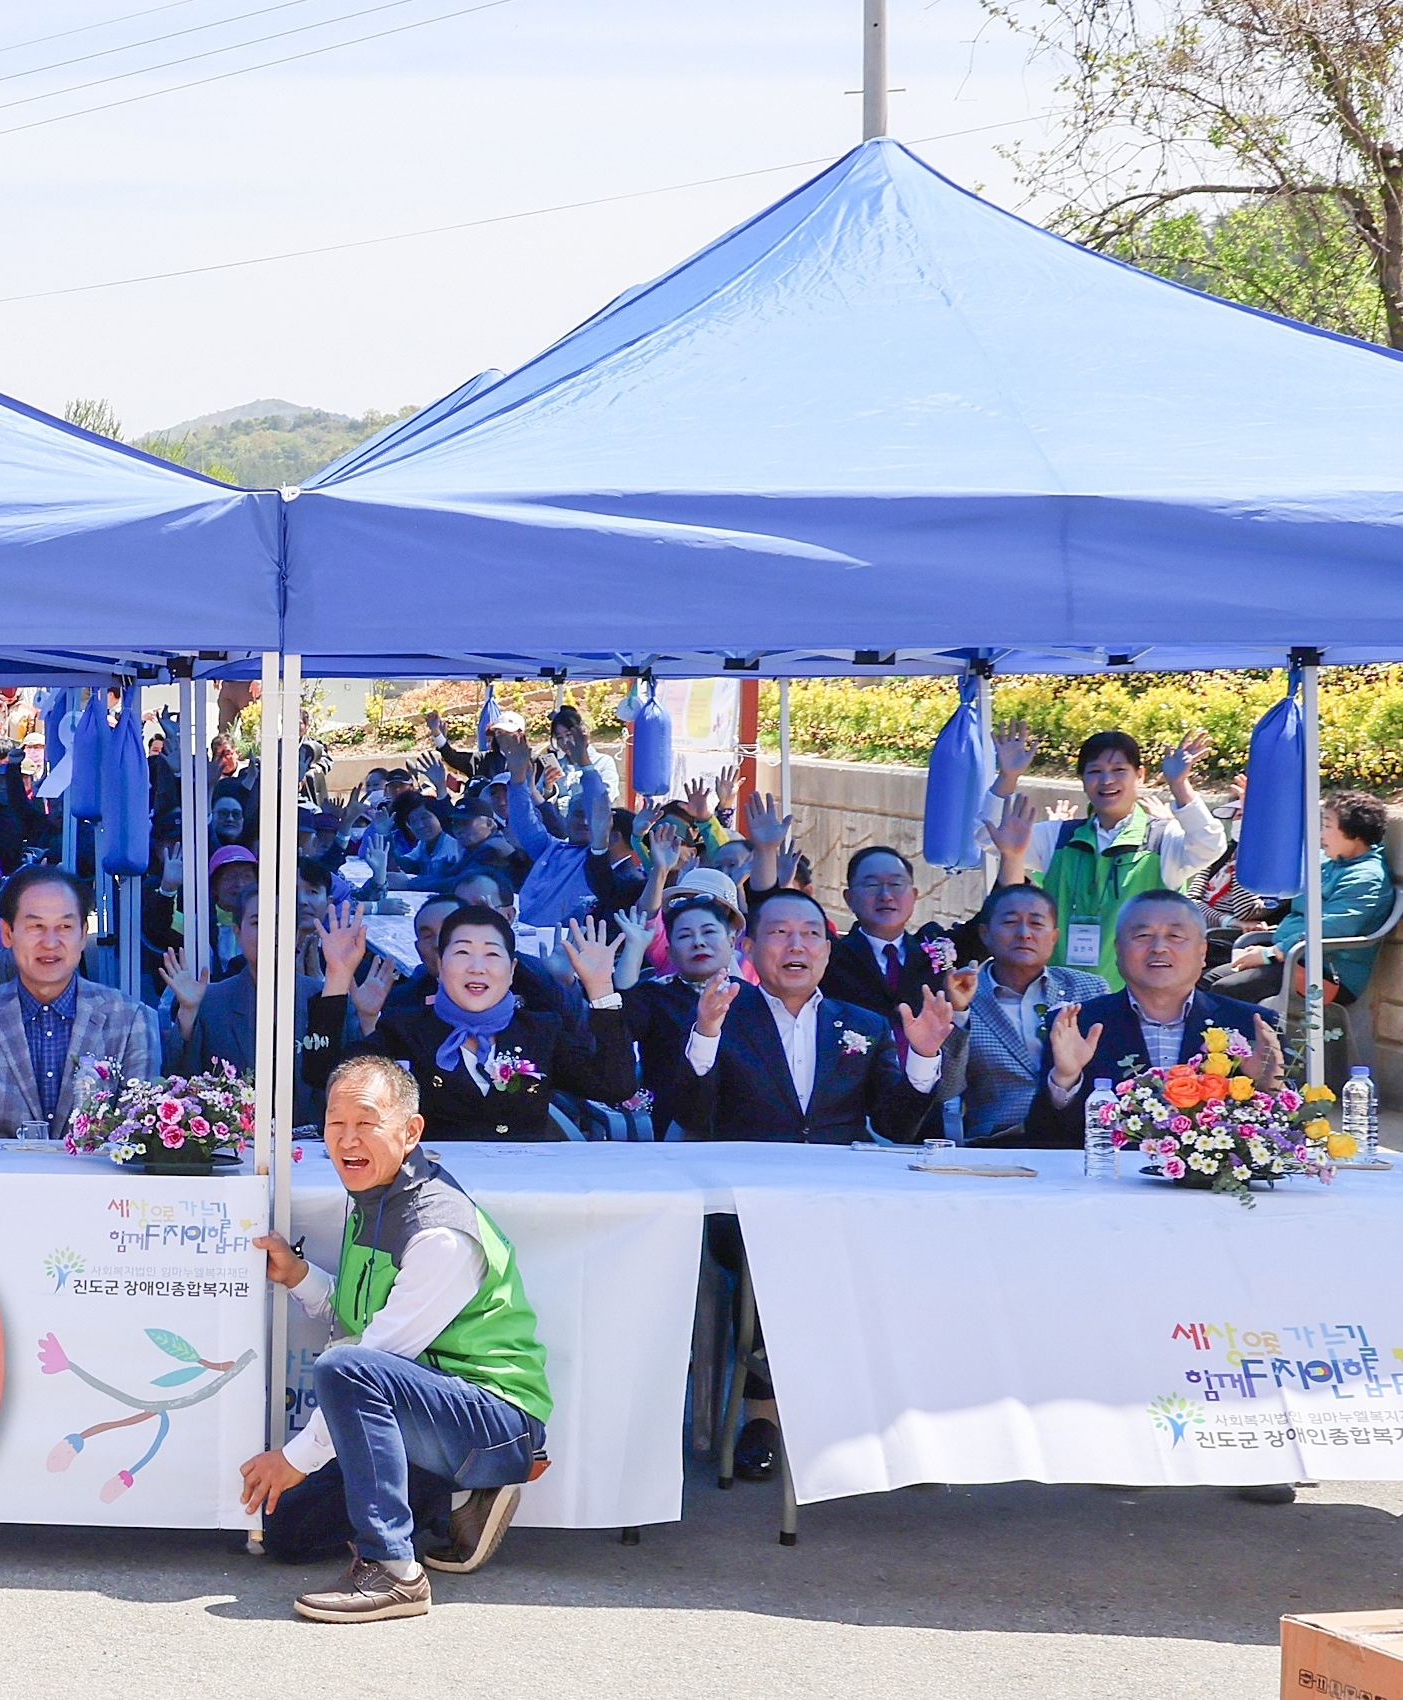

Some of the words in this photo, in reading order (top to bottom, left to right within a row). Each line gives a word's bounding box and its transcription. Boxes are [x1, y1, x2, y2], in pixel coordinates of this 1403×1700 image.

[91, 1265, 157, 1279] 사회복지법인
[161, 1266, 249, 1279] 임마누엘복지재단
[72, 1279, 120, 1296] 진도군
[124, 1280, 250, 1298] 장애인종합복지관
[1308, 1409, 1403, 1425] 임마누엘복지
[1195, 1430, 1259, 1449] 진도군
